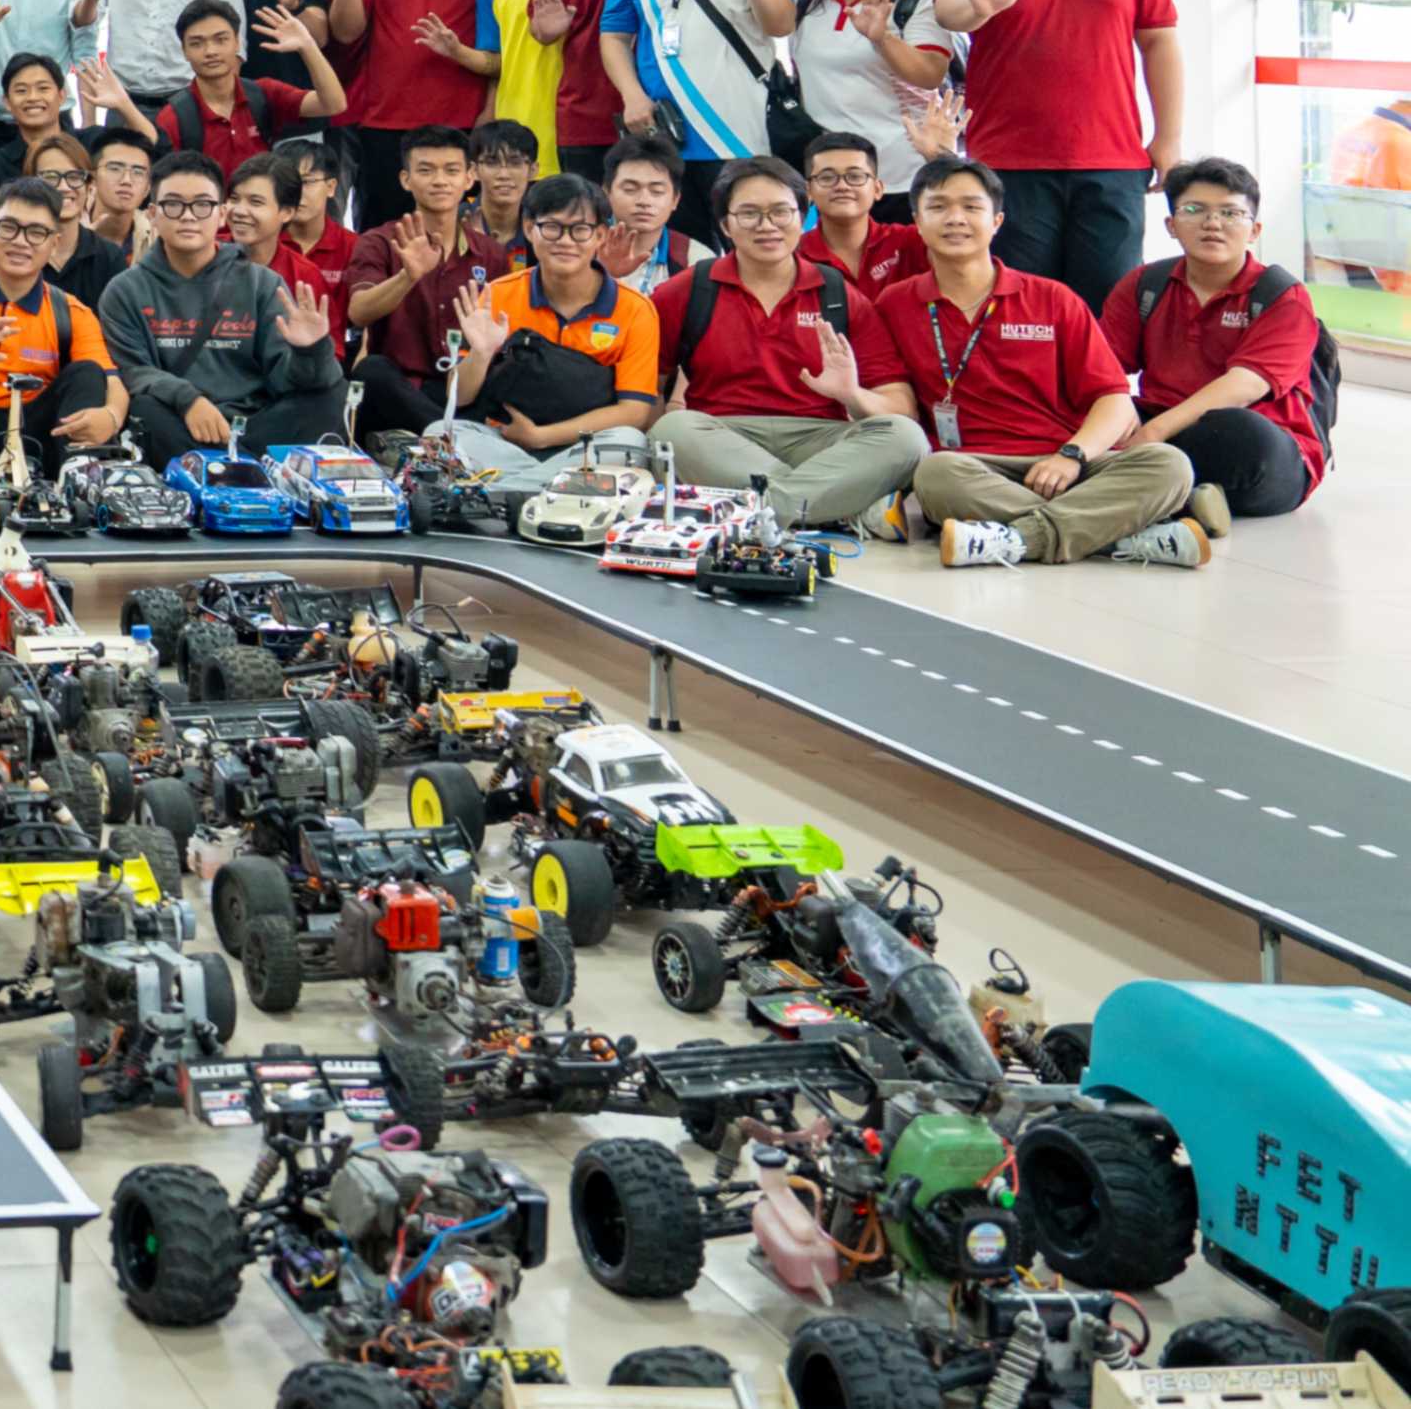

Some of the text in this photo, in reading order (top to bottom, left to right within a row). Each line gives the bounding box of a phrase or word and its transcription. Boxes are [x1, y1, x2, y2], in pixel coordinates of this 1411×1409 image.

[1001, 323, 1055, 336] HUTECH
[1256, 1130, 1363, 1222] FET
[1234, 1182, 1379, 1291] NTTU
[1143, 1368, 1339, 1392] READY-TO-RUN
